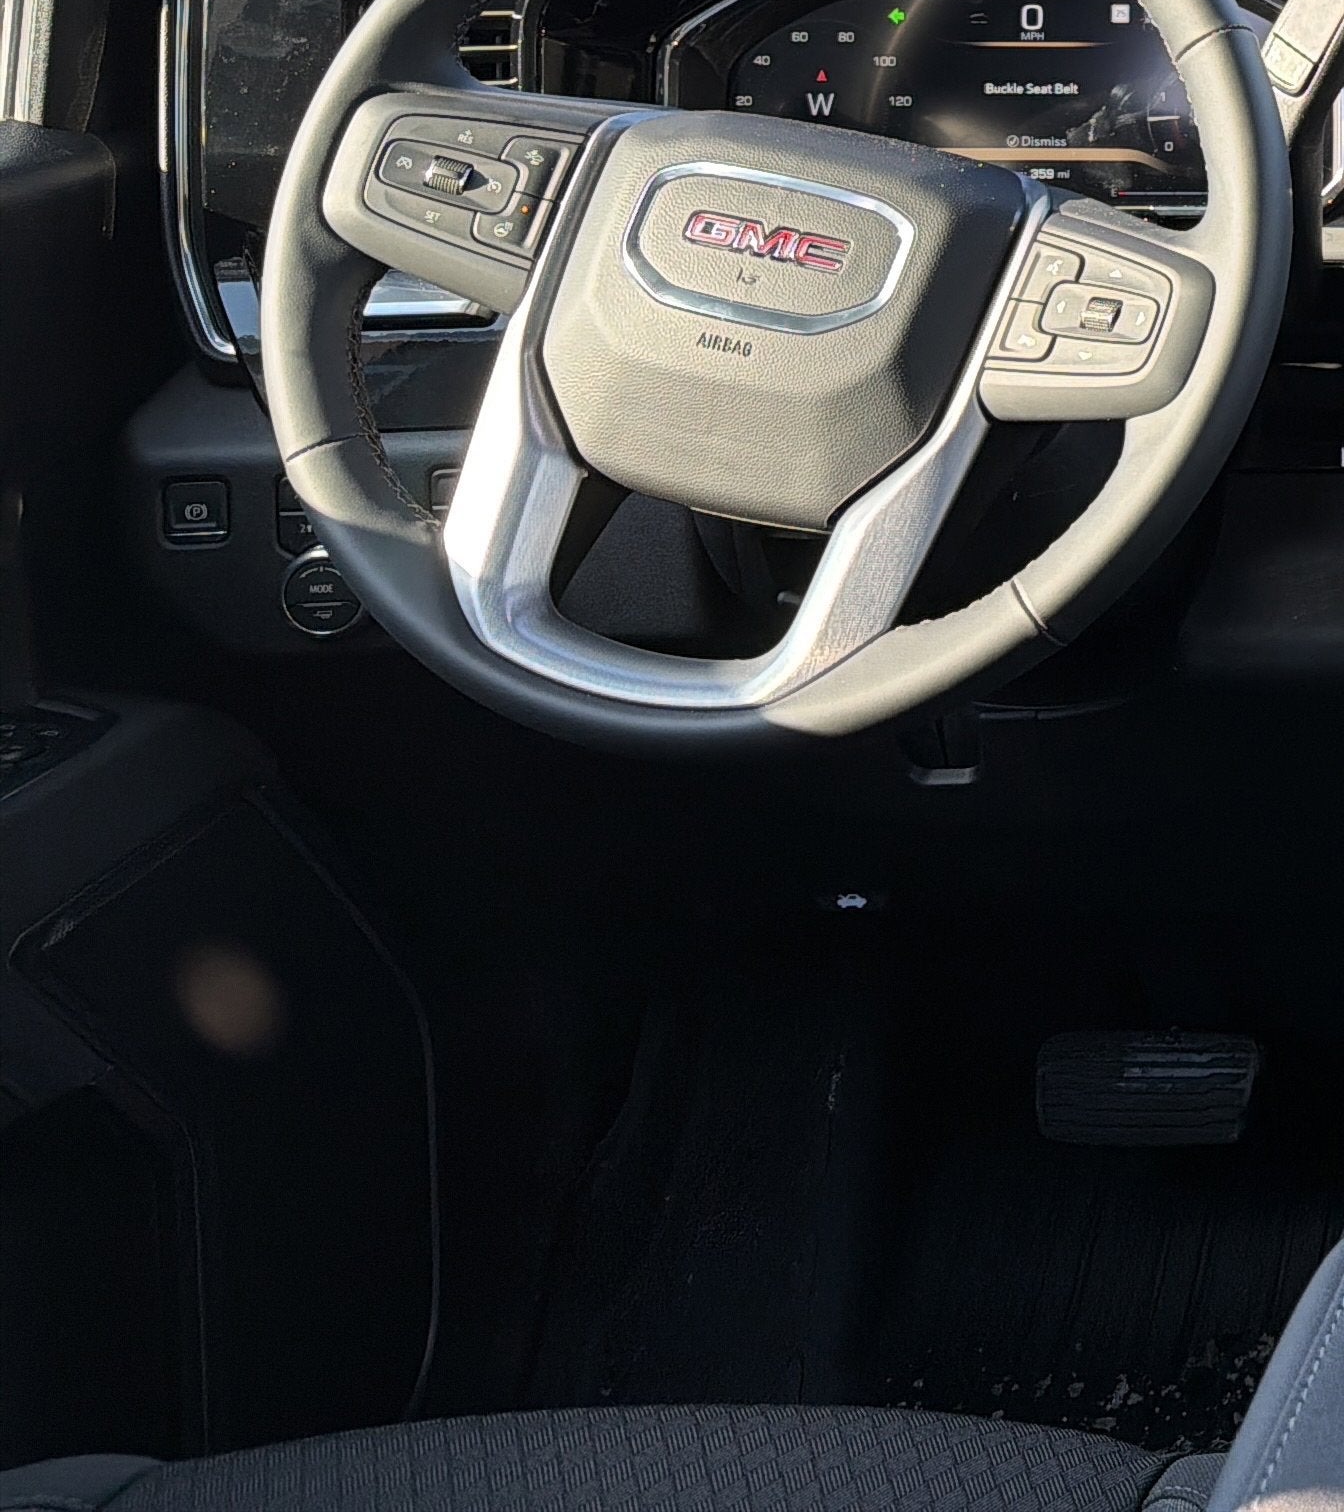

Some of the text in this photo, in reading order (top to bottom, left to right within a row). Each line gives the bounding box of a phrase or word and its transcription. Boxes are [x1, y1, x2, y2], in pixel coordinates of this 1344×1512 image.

[1020, 4, 1045, 31] 0
[791, 32, 809, 43] 60
[838, 32, 855, 43] 80
[1020, 31, 1045, 41] MPH
[752, 55, 771, 66] 40
[873, 56, 897, 67] 100
[984, 82, 1079, 95] Buckle Seat Belt
[735, 95, 753, 107] 20
[806, 92, 835, 117] W
[889, 95, 912, 107] 120
[457, 134, 475, 145] RES
[1021, 135, 1067, 148] Dismiss
[1164, 141, 1174, 152] 0
[1030, 168, 1070, 179] 359 mi
[424, 210, 442, 223] SET
[683, 209, 854, 274] GMC
[696, 331, 753, 358] AIRBAG
[309, 584, 335, 594] MODE
